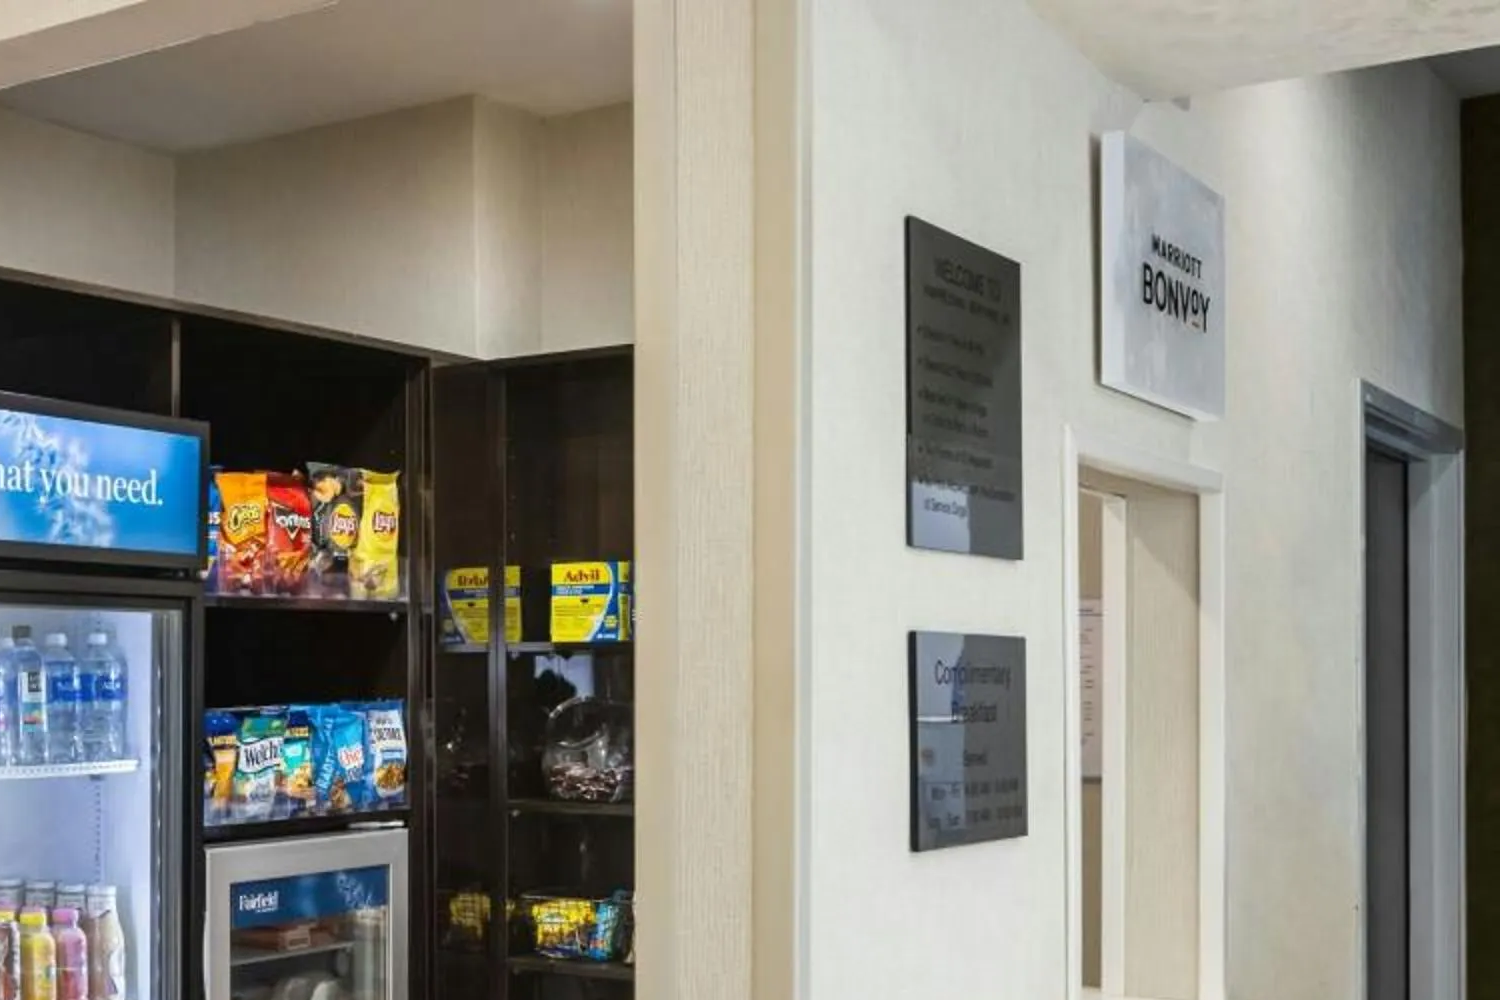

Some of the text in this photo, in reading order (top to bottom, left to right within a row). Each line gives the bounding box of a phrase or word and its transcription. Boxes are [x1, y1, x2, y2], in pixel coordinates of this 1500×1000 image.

[1151, 234, 1203, 279] MARRIOTT
[1141, 262, 1211, 334] BONVOY
[39, 467, 90, 504] you
[96, 468, 164, 507] need.
[563, 568, 601, 583] Advil
[243, 740, 282, 768] Welch
